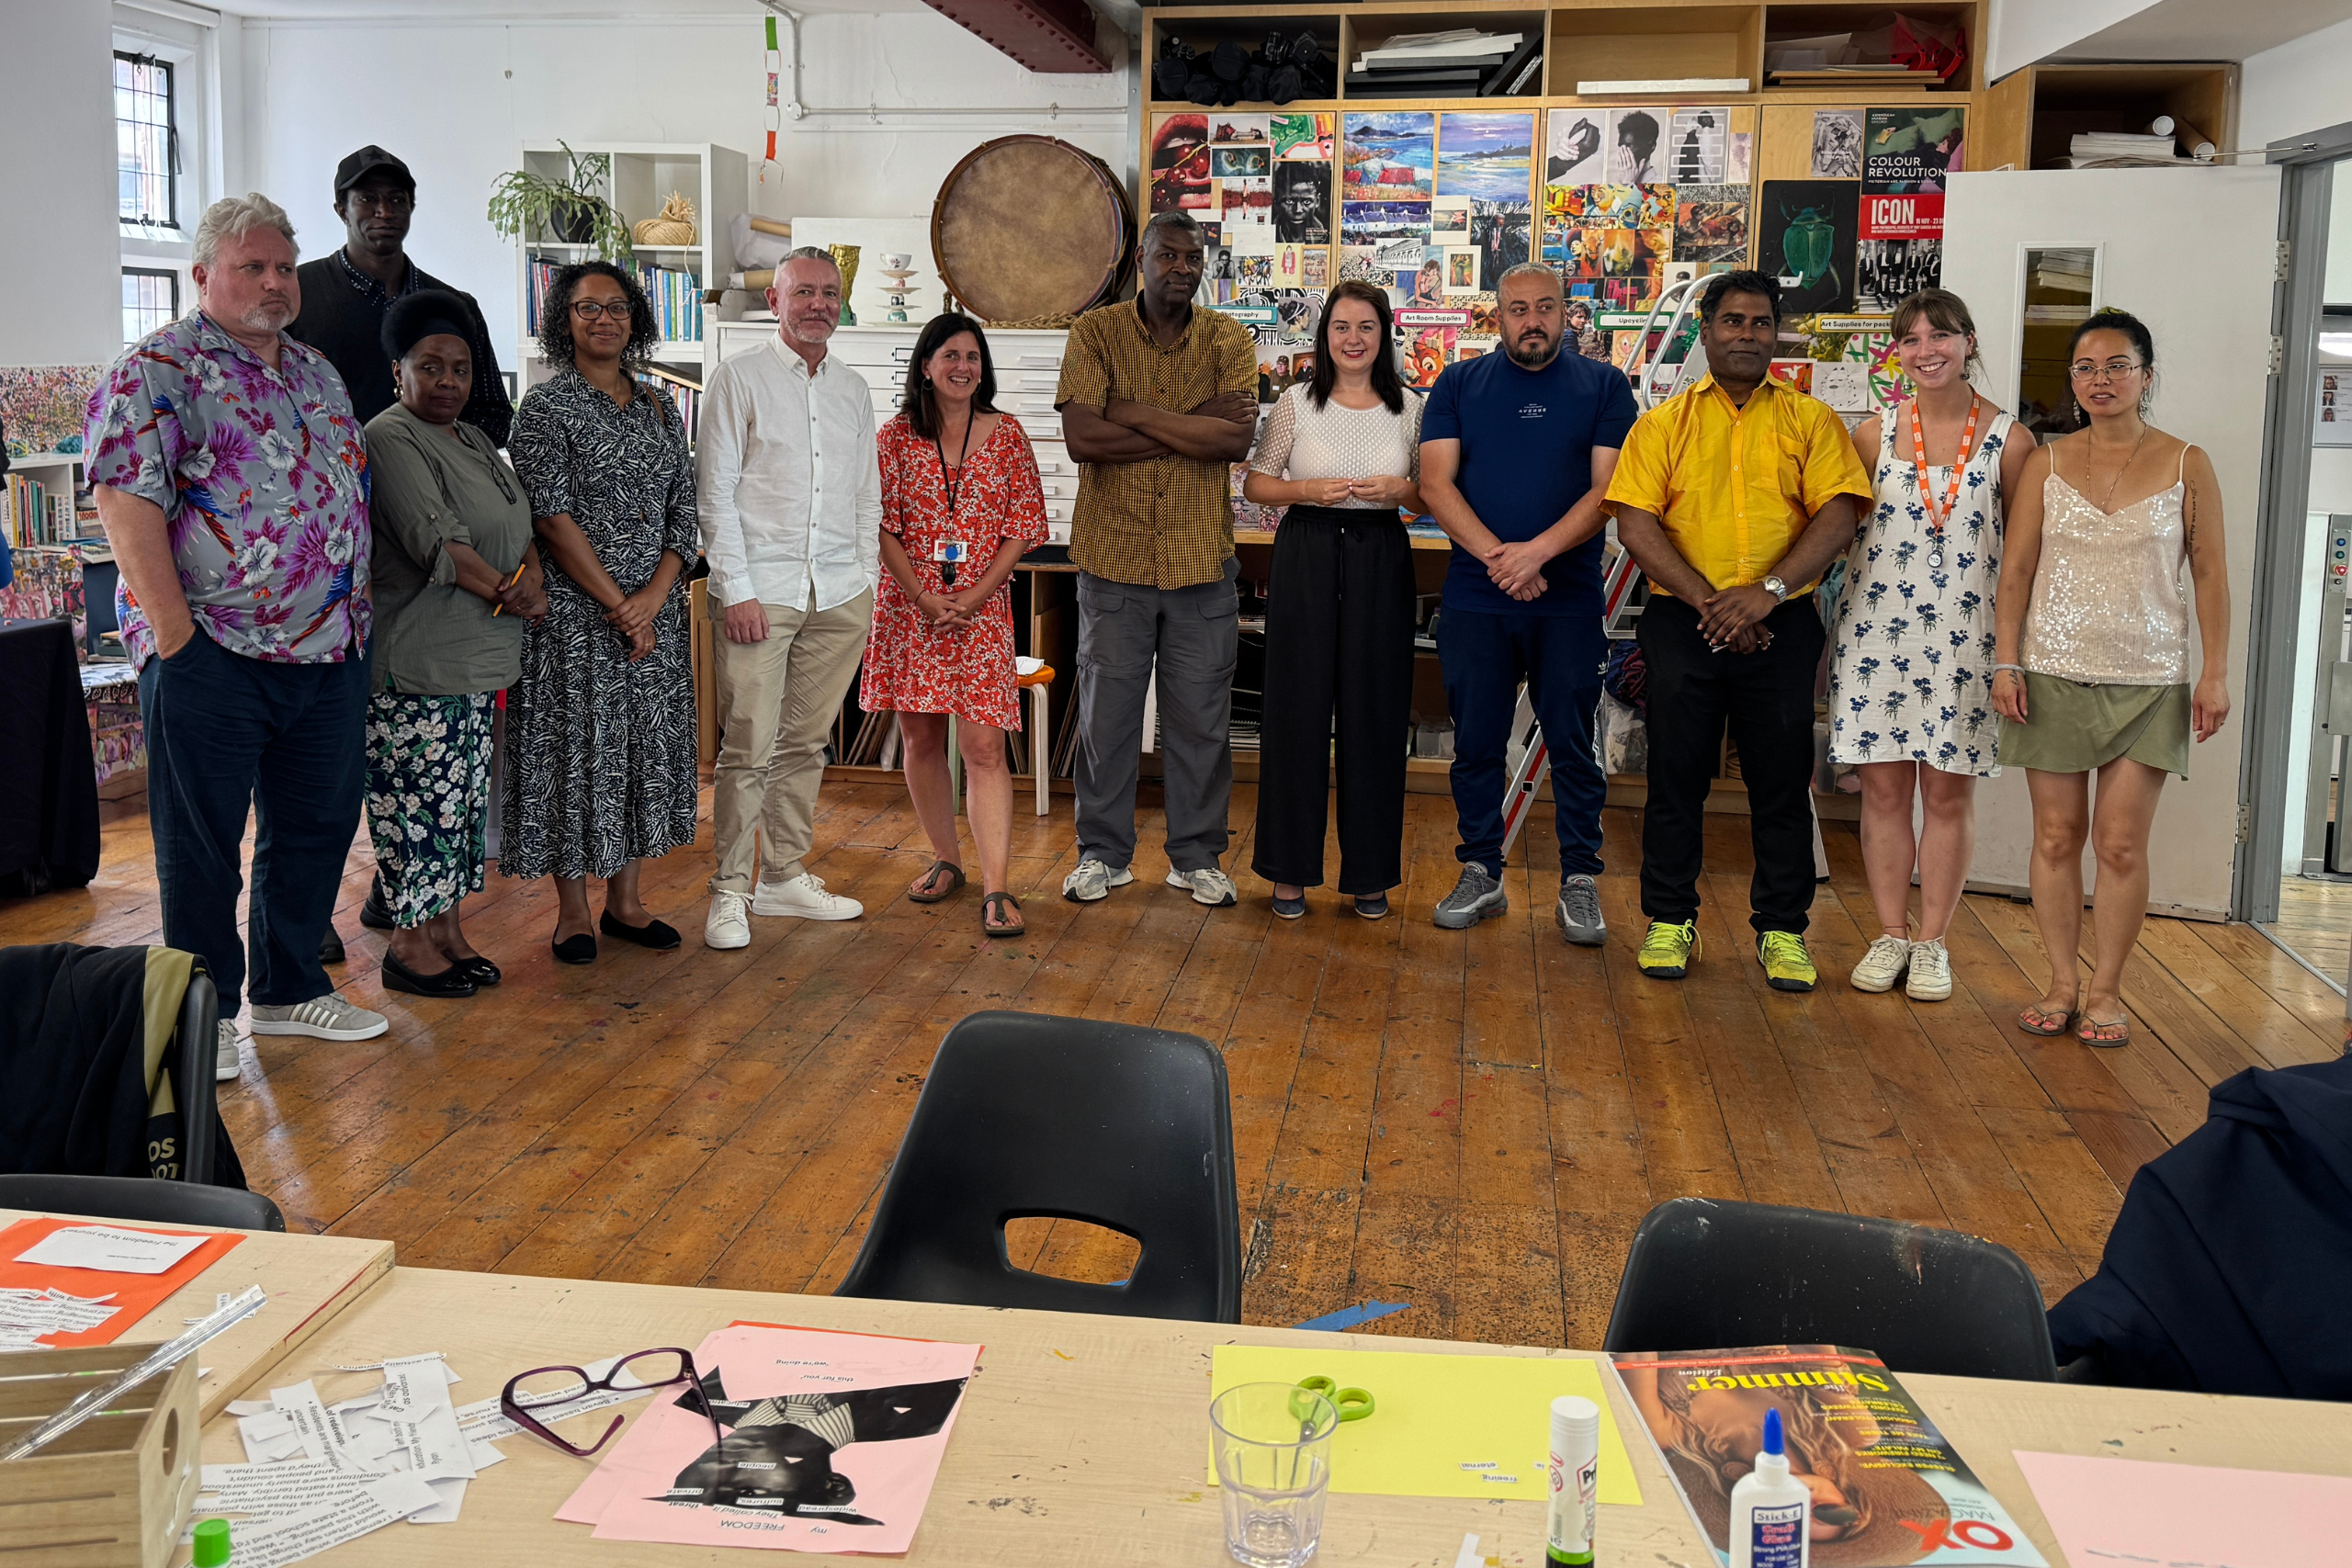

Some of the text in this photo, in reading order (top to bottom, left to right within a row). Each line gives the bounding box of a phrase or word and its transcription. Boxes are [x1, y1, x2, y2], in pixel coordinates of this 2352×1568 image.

[1869, 157, 1921, 166] COLOUR
[1868, 167, 1947, 177] REVOLUTION
[1871, 198, 1915, 225] ICON
[60, 1229, 97, 1238] yourself
[123, 1236, 163, 1246] Freedom
[48, 1290, 65, 1300] with
[57, 1304, 96, 1315] providing
[20, 1313, 57, 1322] promote
[57, 1310, 106, 1321] encouraging
[1687, 1371, 1890, 1392] Summer
[583, 1399, 611, 1410] Bevan
[552, 1407, 581, 1420] based
[294, 1409, 311, 1435] uncertain
[309, 1405, 328, 1441] Residents are
[459, 1422, 486, 1433] simila
[328, 1416, 346, 1447] redevelop
[471, 1433, 497, 1443] ideas
[288, 1462, 322, 1471] they'd
[1482, 1474, 1517, 1482] freeing
[295, 1483, 334, 1492] treated
[220, 1495, 280, 1505] psychiatric
[331, 1491, 368, 1507] before.
[349, 1497, 374, 1510] from
[357, 1503, 380, 1515] with
[669, 1501, 700, 1509] threat
[722, 1506, 754, 1516] called
[758, 1509, 779, 1519] They
[1894, 1508, 1995, 1521] MAGAZINE
[312, 1512, 338, 1523] state
[336, 1514, 356, 1524] this
[275, 1521, 310, 1535] school
[721, 1519, 785, 1531] FREEDOM
[810, 1526, 828, 1534] my
[248, 1509, 387, 1562] would often say things like
[334, 1519, 387, 1543] remember
[1897, 1518, 2014, 1552] OX
[252, 1534, 272, 1543] and
[253, 1543, 276, 1553] Well
[302, 1541, 332, 1554] when
[268, 1551, 302, 1566] being
